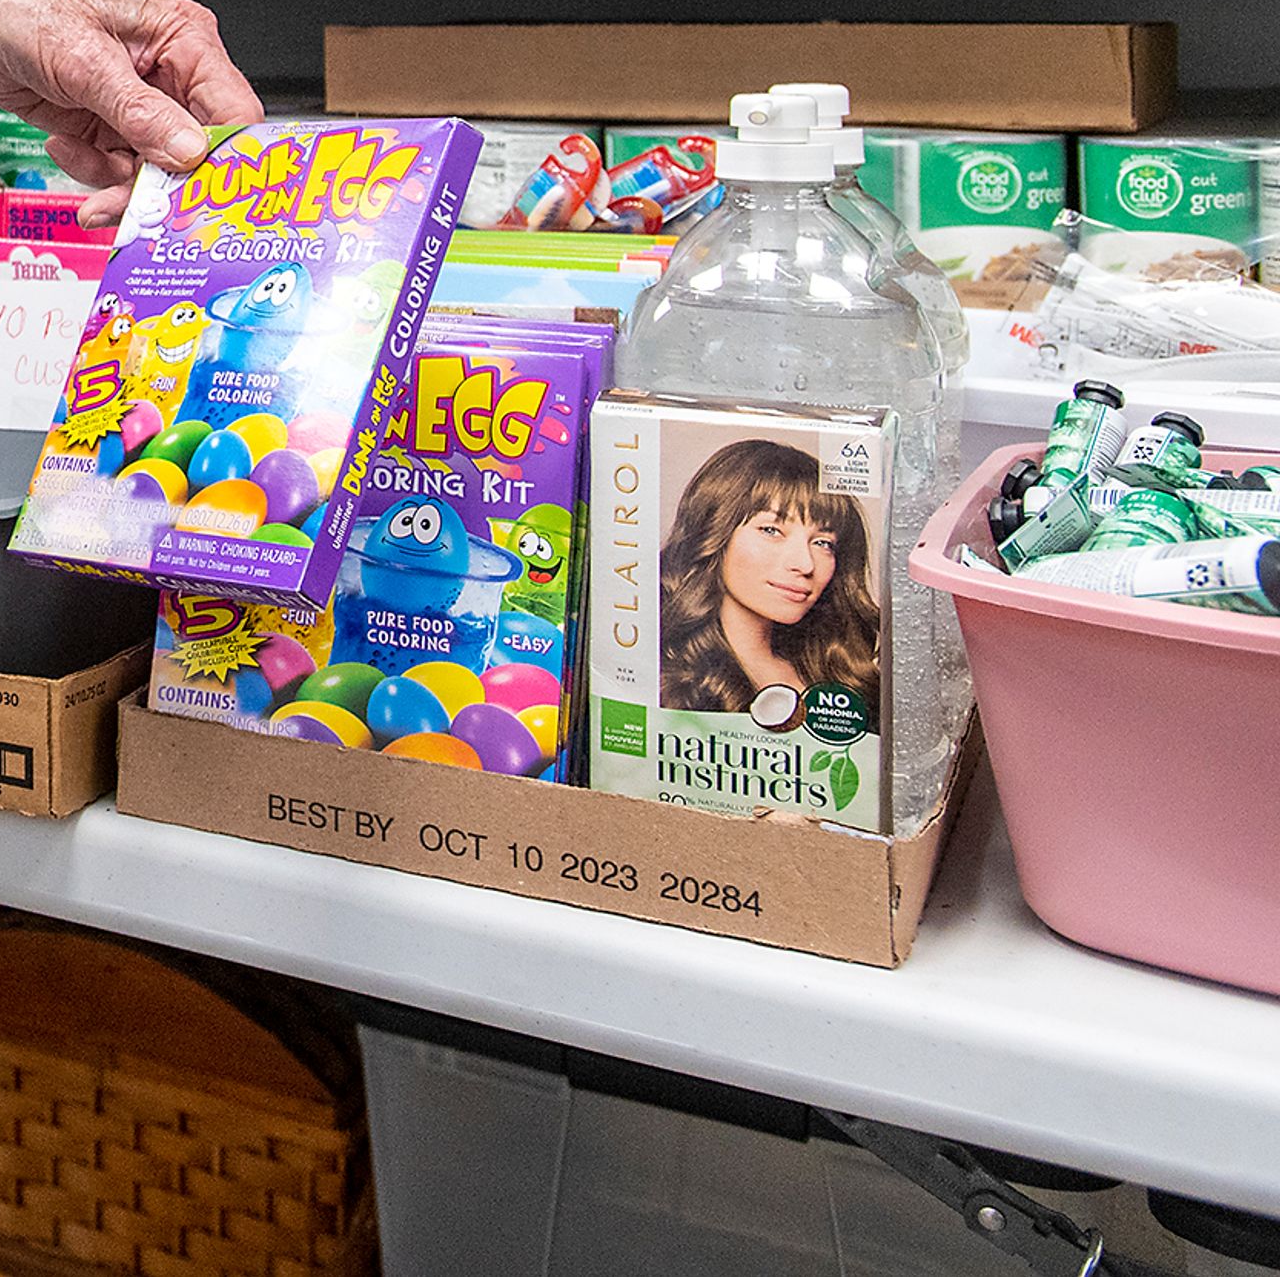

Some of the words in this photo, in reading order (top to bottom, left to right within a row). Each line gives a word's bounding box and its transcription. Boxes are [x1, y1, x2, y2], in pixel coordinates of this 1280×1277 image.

[179, 139, 302, 214] DUNK
[294, 130, 423, 224] EGG
[970, 170, 1009, 186] food
[1027, 169, 1048, 182] cut
[1128, 173, 1169, 189] food
[1190, 173, 1218, 188] cut
[971, 185, 1008, 199] club
[1130, 188, 1168, 204] club
[252, 185, 300, 221] AN
[1190, 191, 1245, 215] green
[151, 238, 206, 264] EGG
[208, 236, 326, 263] COLORING
[334, 236, 382, 264] KIT
[389, 234, 442, 359] COLORING
[430, 182, 459, 229] KIT
[72, 362, 122, 413] 5
[211, 371, 244, 388] PURE
[246, 373, 280, 389] FOOD
[208, 387, 273, 405] COLORING
[414, 355, 551, 459] EGG
[341, 427, 379, 497] DUNK
[372, 364, 398, 409] EGG
[840, 442, 870, 460] 6A
[42, 455, 96, 474] CONTAINS:
[824, 464, 843, 473] COOL
[844, 466, 870, 474] BROWN
[368, 465, 467, 500] ORING
[481, 470, 535, 505] KIT
[826, 483, 848, 491] CLAIR
[849, 484, 870, 493] FROID
[327, 504, 345, 540] Easter
[178, 537, 218, 558] WARNING:
[220, 542, 260, 563] CHOKING
[613, 432, 642, 650] CLAIROL
[177, 595, 242, 640] 5
[366, 610, 408, 632] PURE
[411, 614, 455, 635] FOOD
[366, 629, 452, 654] COLORING
[615, 675, 636, 684] YORK
[617, 666, 635, 674] NEW
[157, 685, 236, 711] CONTAINS:
[818, 691, 851, 708] NO
[624, 722, 644, 732] NEW
[812, 723, 858, 735] PARABENS
[604, 733, 644, 746] NOUVEAU
[719, 730, 754, 742] HEALTHY
[756, 734, 792, 747] LOOKING
[657, 731, 802, 776] natural
[657, 760, 828, 808] instincts
[697, 797, 746, 811] NATURALLY
[268, 793, 346, 832] BEST
[354, 809, 395, 842] BY
[418, 822, 488, 861] OCT
[508, 841, 543, 873] 10
[560, 852, 640, 893] 2023
[659, 871, 764, 918] 20284
